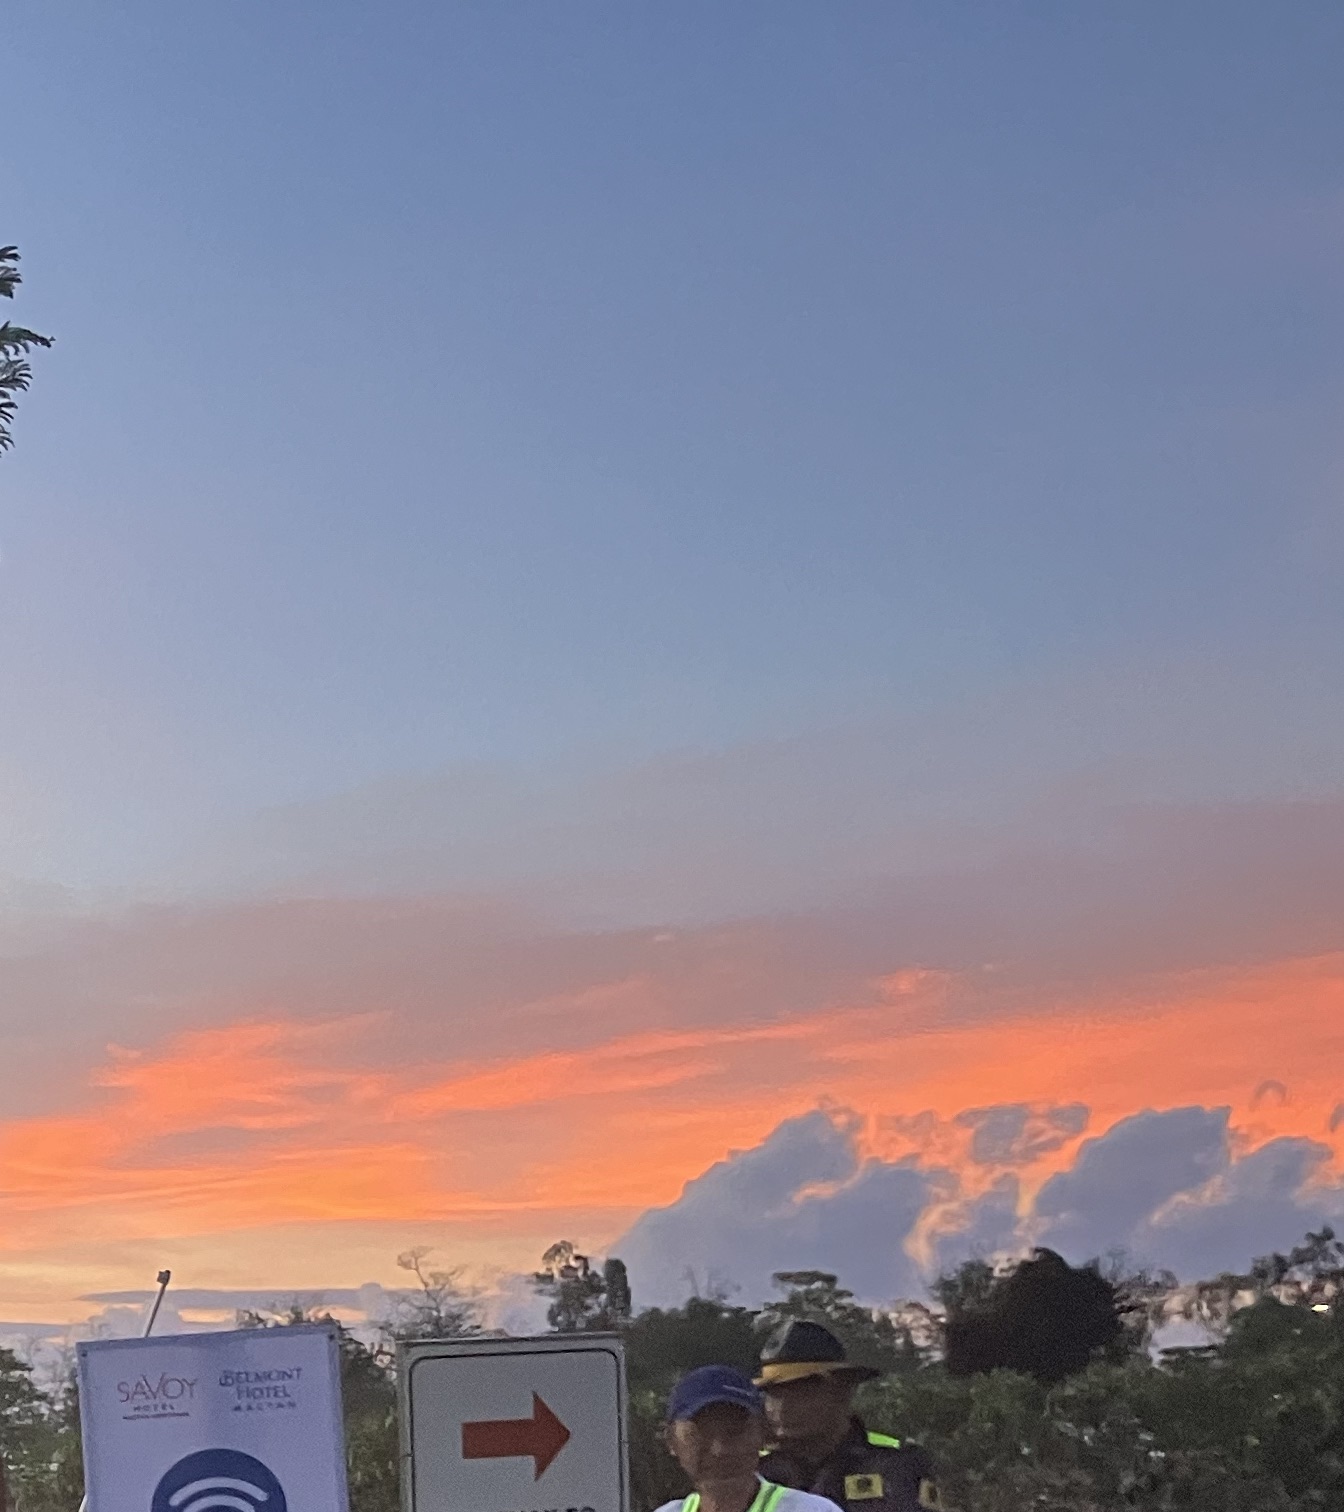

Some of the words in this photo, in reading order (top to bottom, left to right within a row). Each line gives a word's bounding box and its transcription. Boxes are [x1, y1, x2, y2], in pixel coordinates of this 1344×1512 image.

[219, 1367, 302, 1387] BELMONT
[117, 1372, 198, 1403] SAVOY
[236, 1385, 290, 1400] HOTEL
